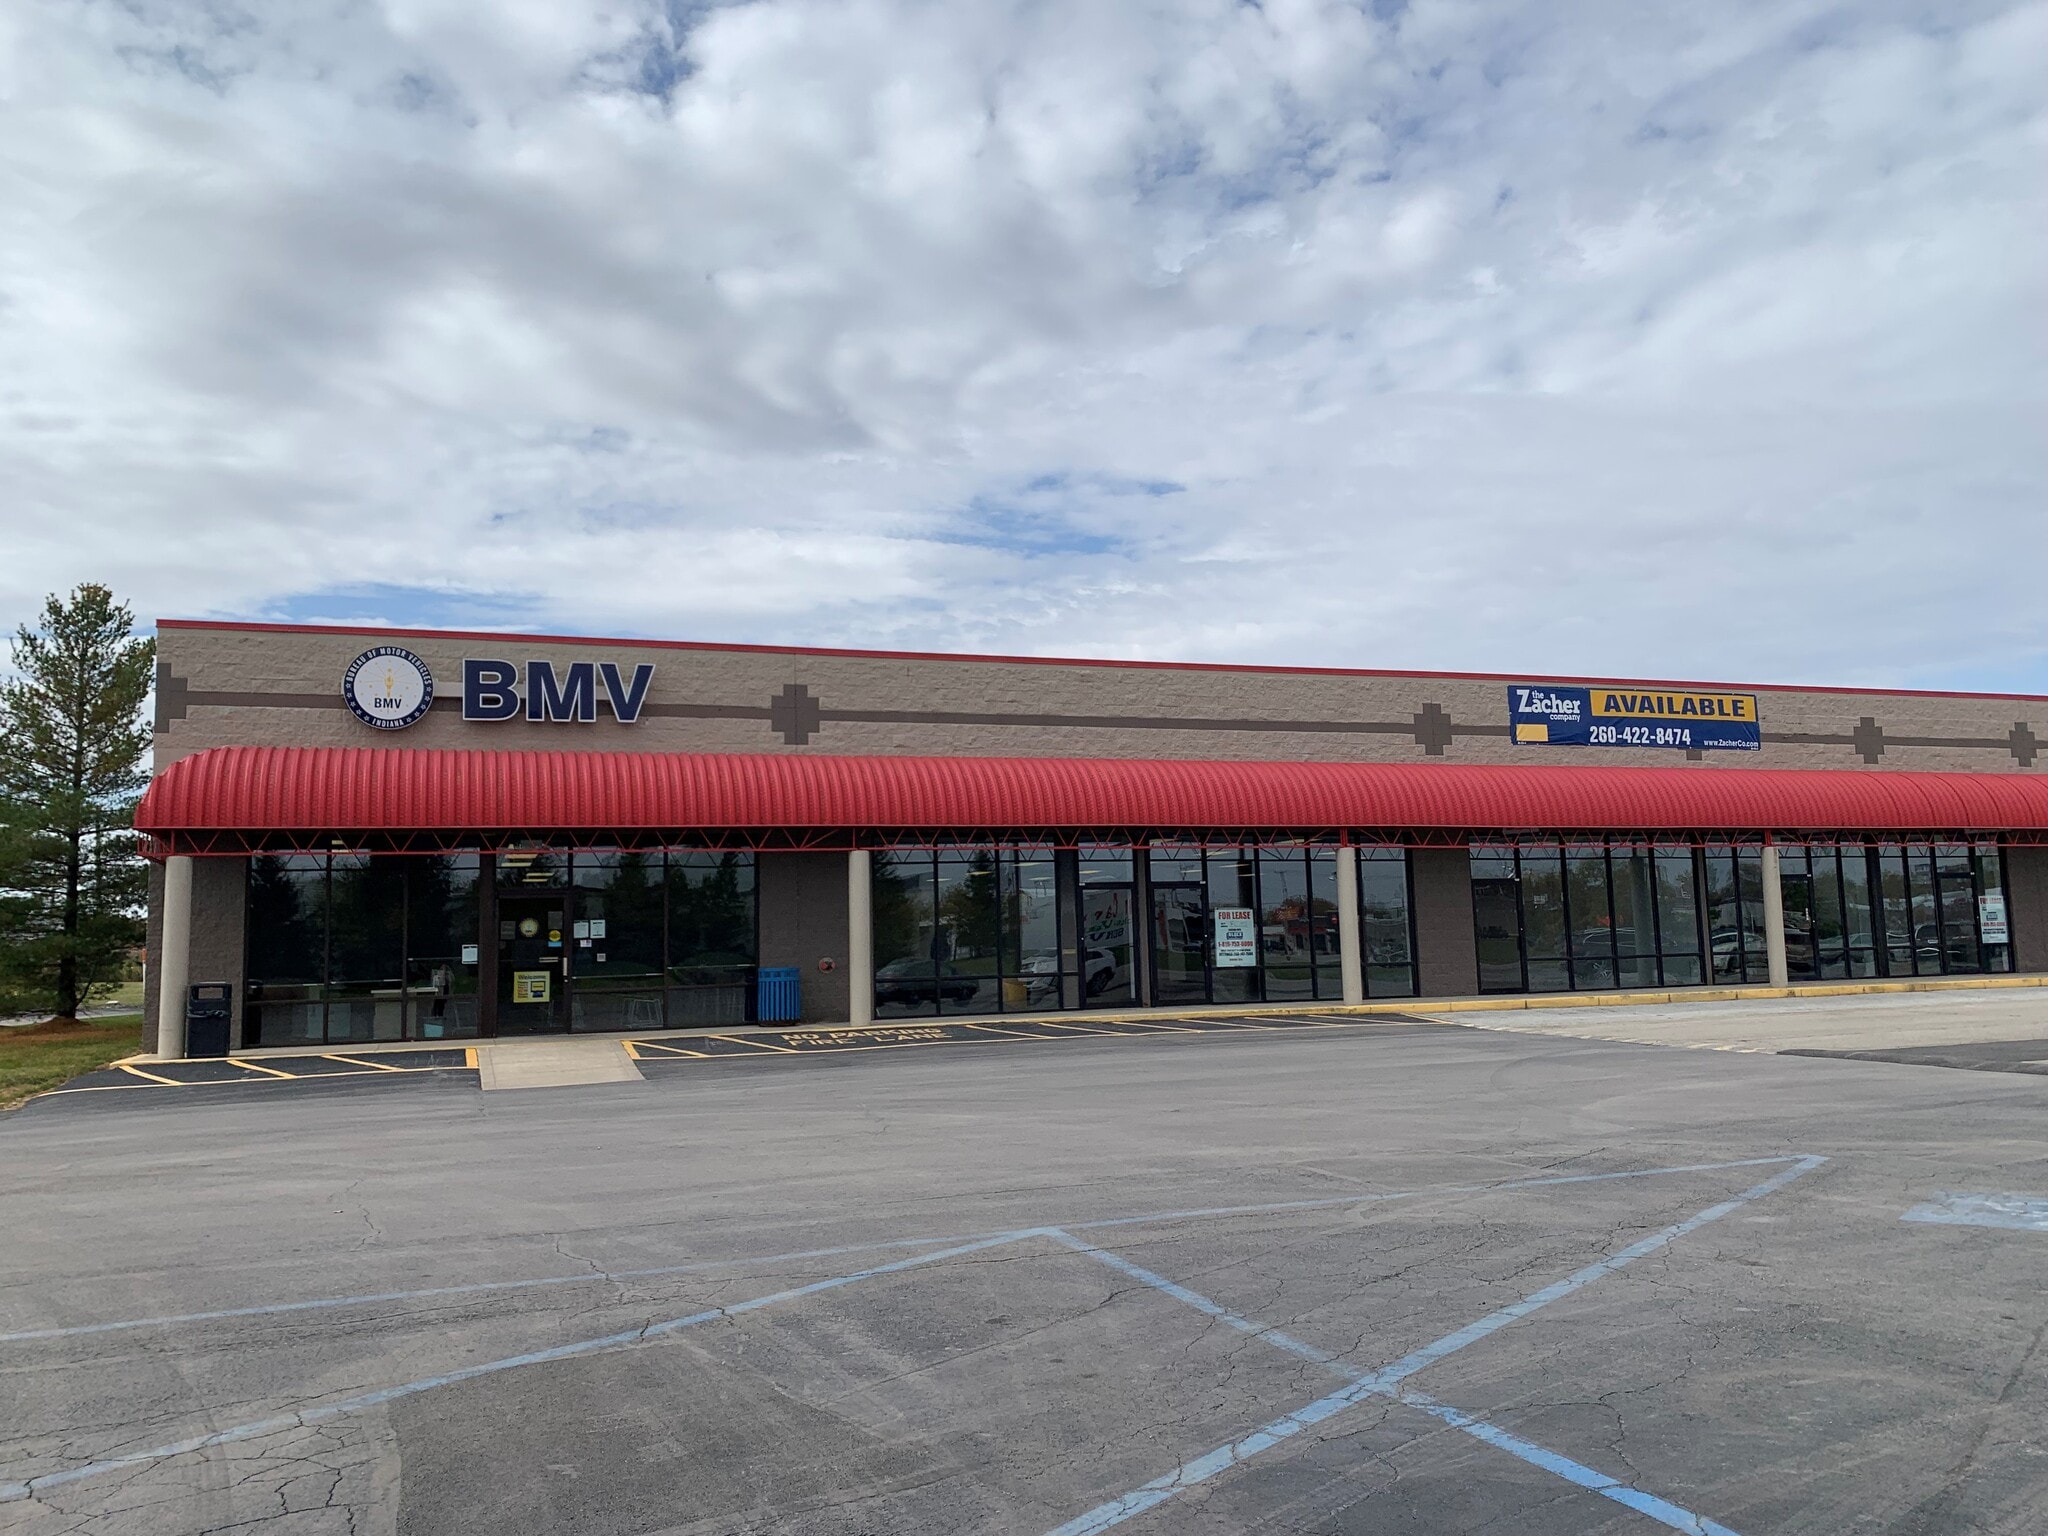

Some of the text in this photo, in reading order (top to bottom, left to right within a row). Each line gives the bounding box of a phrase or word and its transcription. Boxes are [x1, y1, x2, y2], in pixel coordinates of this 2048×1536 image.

[345, 656, 367, 682] BUREAU
[380, 647, 407, 657] MOTOR
[407, 653, 432, 685] VEHICLES
[463, 658, 656, 723] BMV
[1532, 690, 1544, 699] the
[374, 697, 402, 709] BMV
[1516, 689, 1580, 714] Zacher
[1604, 695, 1745, 717] AVAILABLE
[371, 718, 405, 728] INDIANA
[1549, 713, 1581, 723] company
[1589, 725, 1692, 746] 260-422-8474
[1703, 739, 1758, 747] www.ZacherCo.com
[1219, 911, 1250, 919] FOR LEASE
[781, 1028, 942, 1041] NO PARKING
[788, 1033, 953, 1046] FIRE LANE
